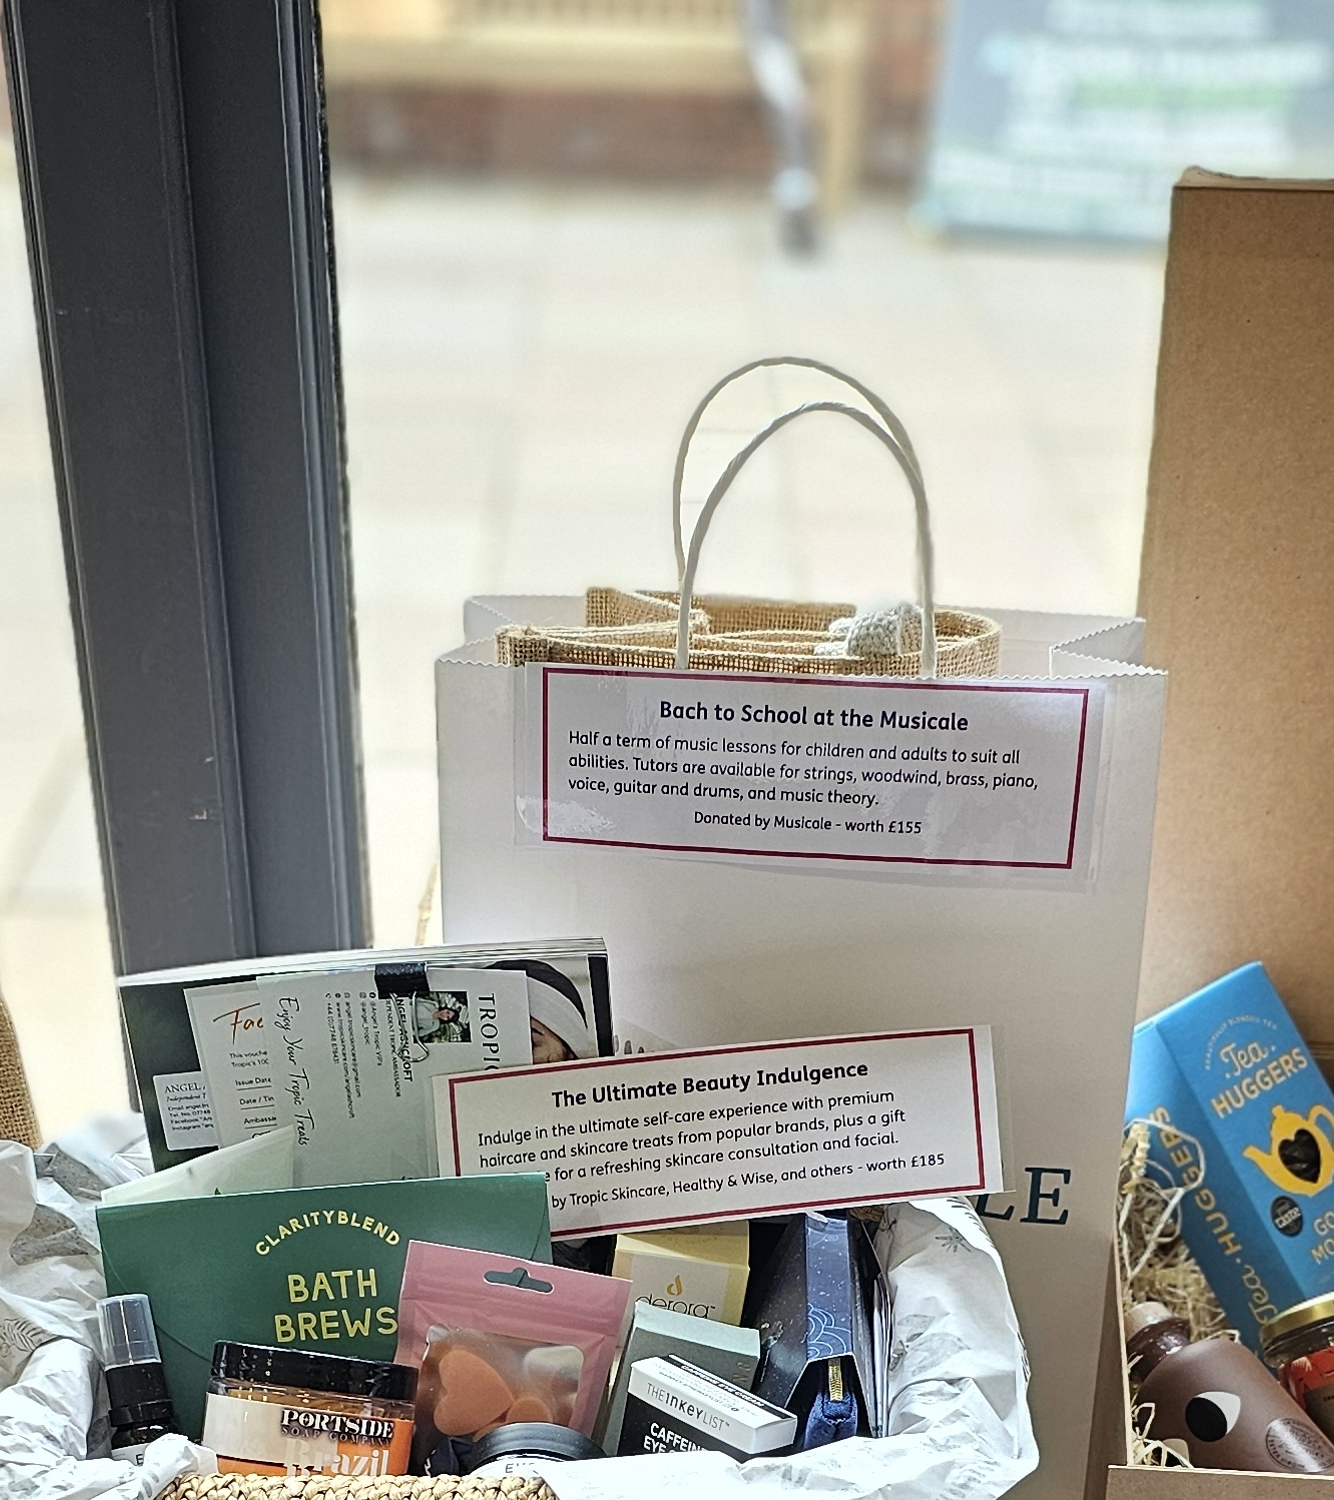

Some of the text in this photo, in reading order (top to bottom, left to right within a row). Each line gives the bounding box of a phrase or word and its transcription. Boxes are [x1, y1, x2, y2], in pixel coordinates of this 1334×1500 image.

[659, 701, 968, 730] Bach to School at the Musicale
[569, 777, 879, 808] voice, guitar and drums, and music theory.
[278, 996, 315, 1146] Enjoy Your Tropic Treats
[1220, 1041, 1268, 1076] Tea
[165, 1082, 200, 1094] ANGEL
[552, 1065, 868, 1108] The Ultimate Beauty Indulgence
[1210, 1048, 1308, 1118] HUGGERS
[255, 1210, 401, 1256] CLARITYBLEND
[287, 1268, 377, 1303] BATH
[274, 1306, 399, 1343] BREWS
[280, 1409, 395, 1439] PORTSIDE
[281, 1425, 392, 1447] SOAP COMPANY
[643, 1436, 668, 1454] EYE
